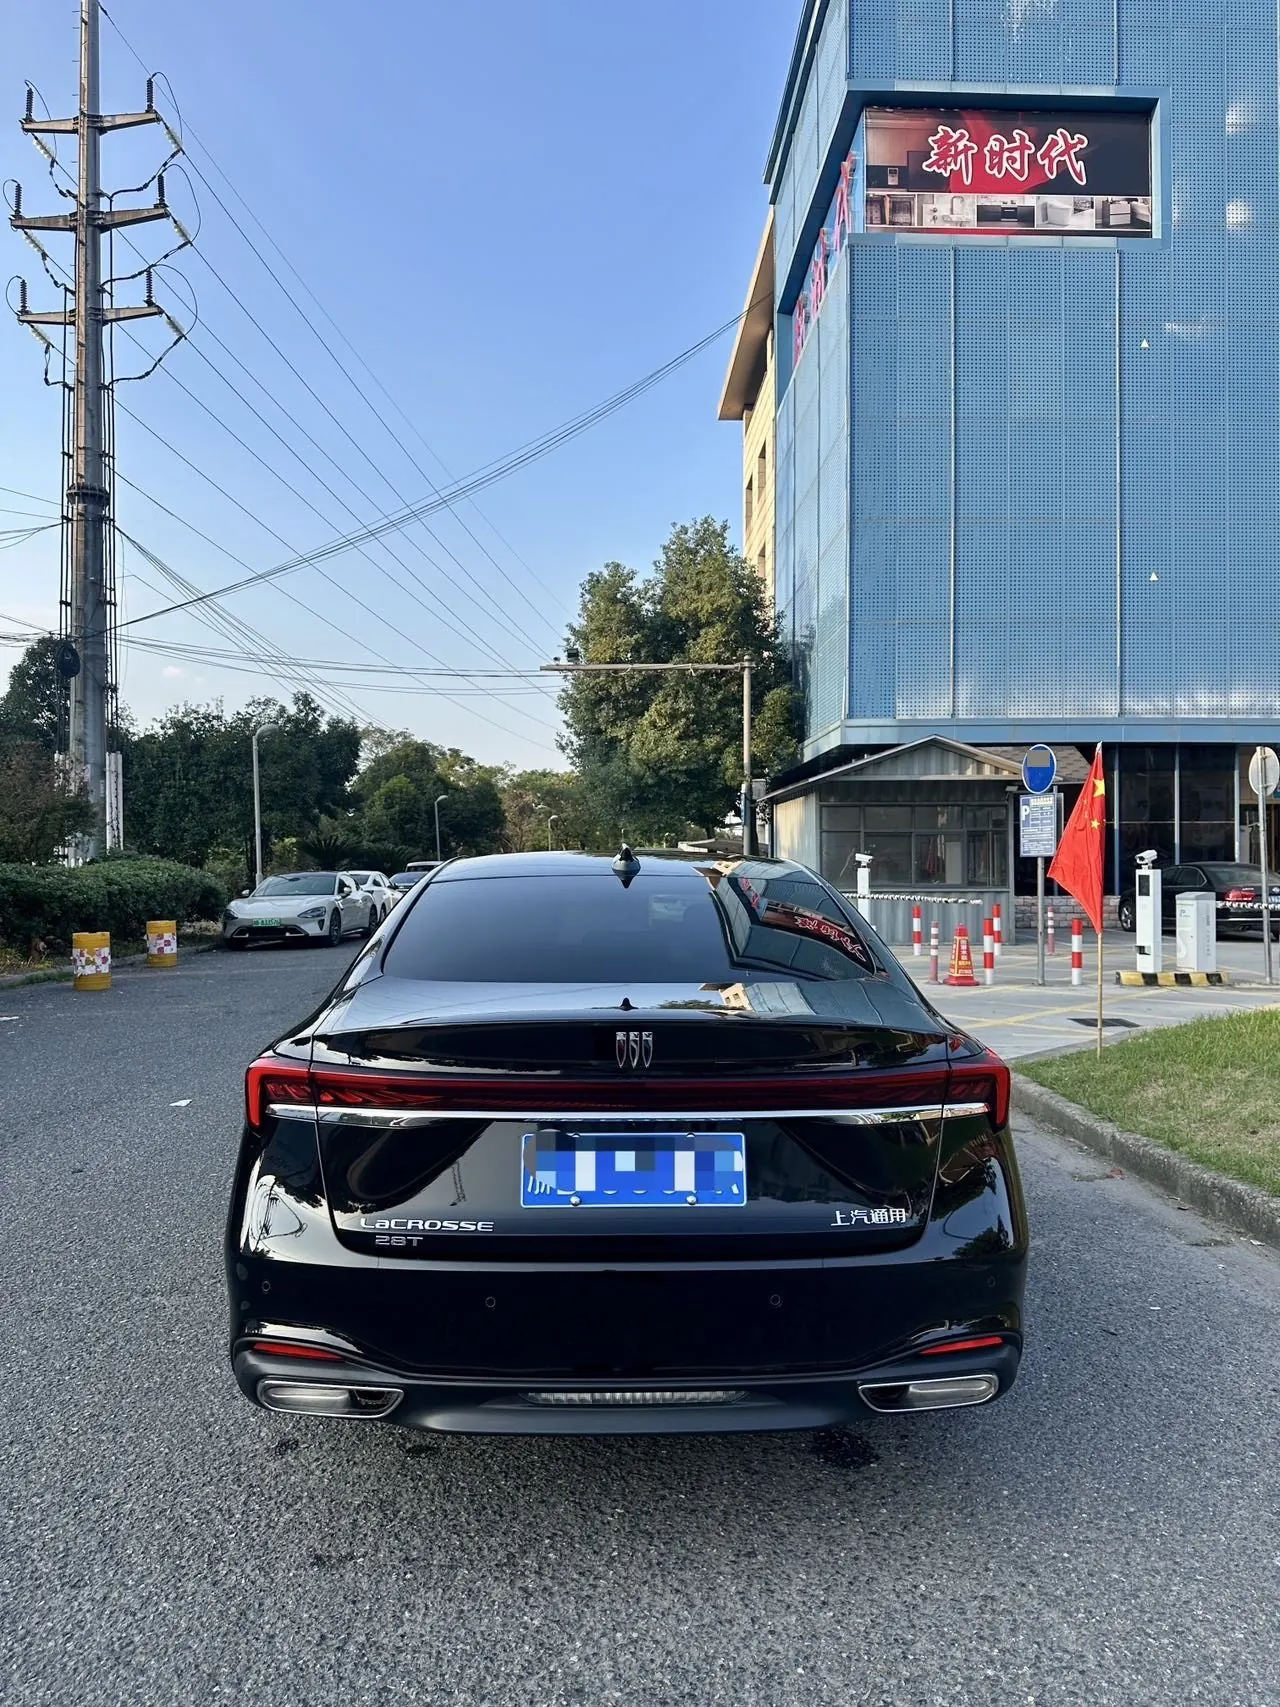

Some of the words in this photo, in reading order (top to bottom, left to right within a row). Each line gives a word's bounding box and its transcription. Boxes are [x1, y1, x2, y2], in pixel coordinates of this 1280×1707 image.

[922, 125, 1088, 185] 新时代
[1022, 805, 1030, 820] P
[830, 1208, 906, 1226] 上汽通用
[375, 1235, 424, 1247] 28T
